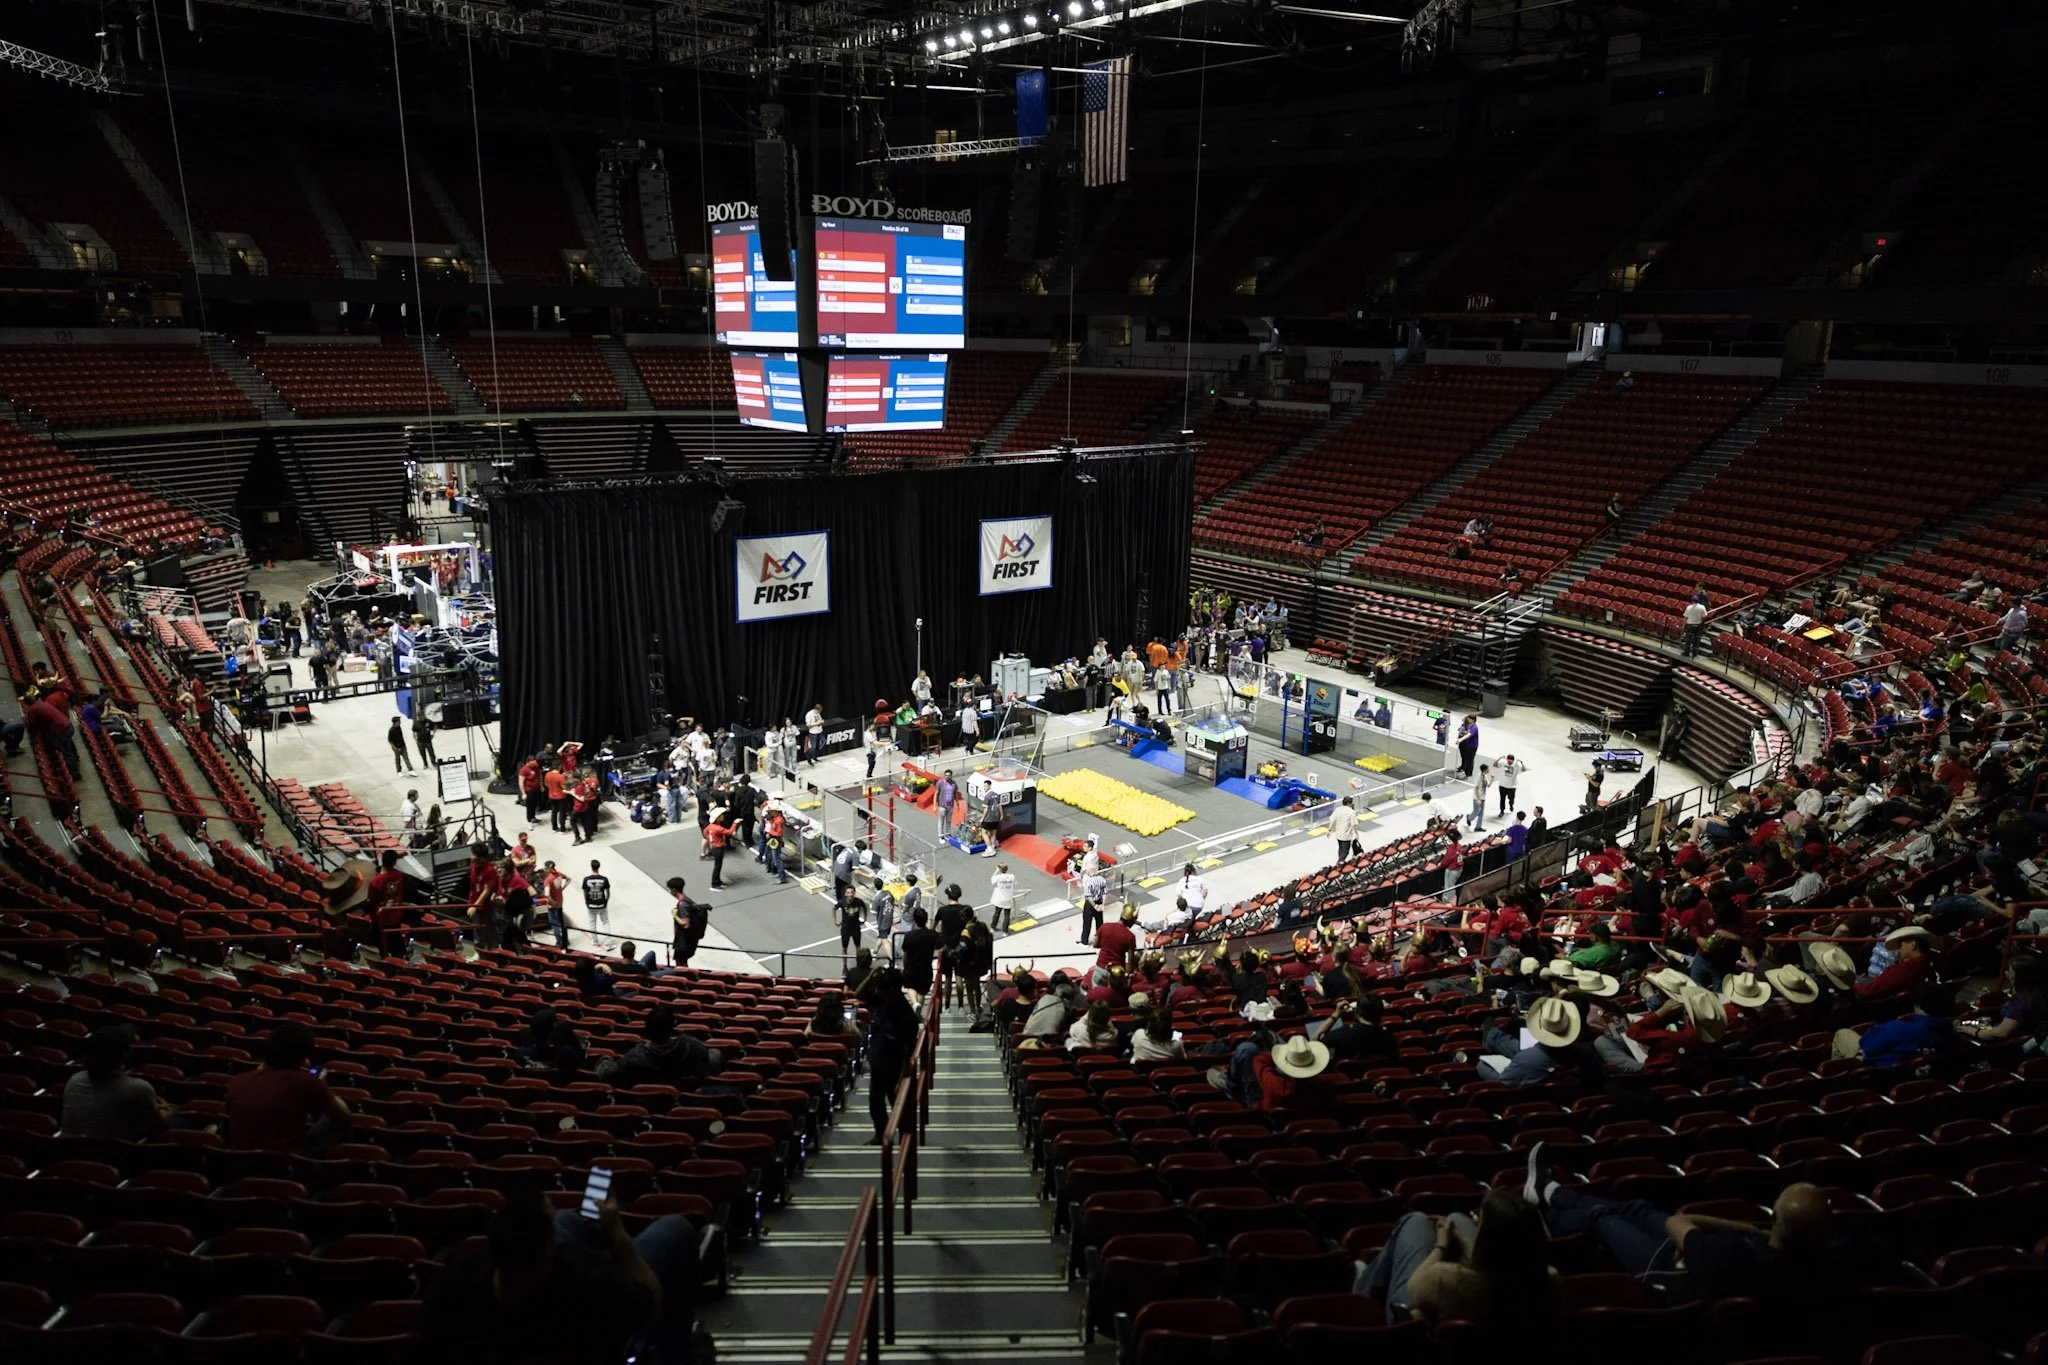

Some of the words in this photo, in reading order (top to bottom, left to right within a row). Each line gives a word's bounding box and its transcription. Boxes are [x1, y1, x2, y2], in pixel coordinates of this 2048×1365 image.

[707, 201, 750, 222] BOYD
[812, 194, 894, 219] BOYD
[897, 207, 972, 224] SCOREBOARD
[1485, 353, 1502, 365] 106
[1679, 358, 1699, 372] 107
[1986, 368, 2010, 383] 108
[992, 560, 1040, 580] FIRST
[753, 581, 813, 605] FIRST
[826, 728, 856, 746] FIRST
